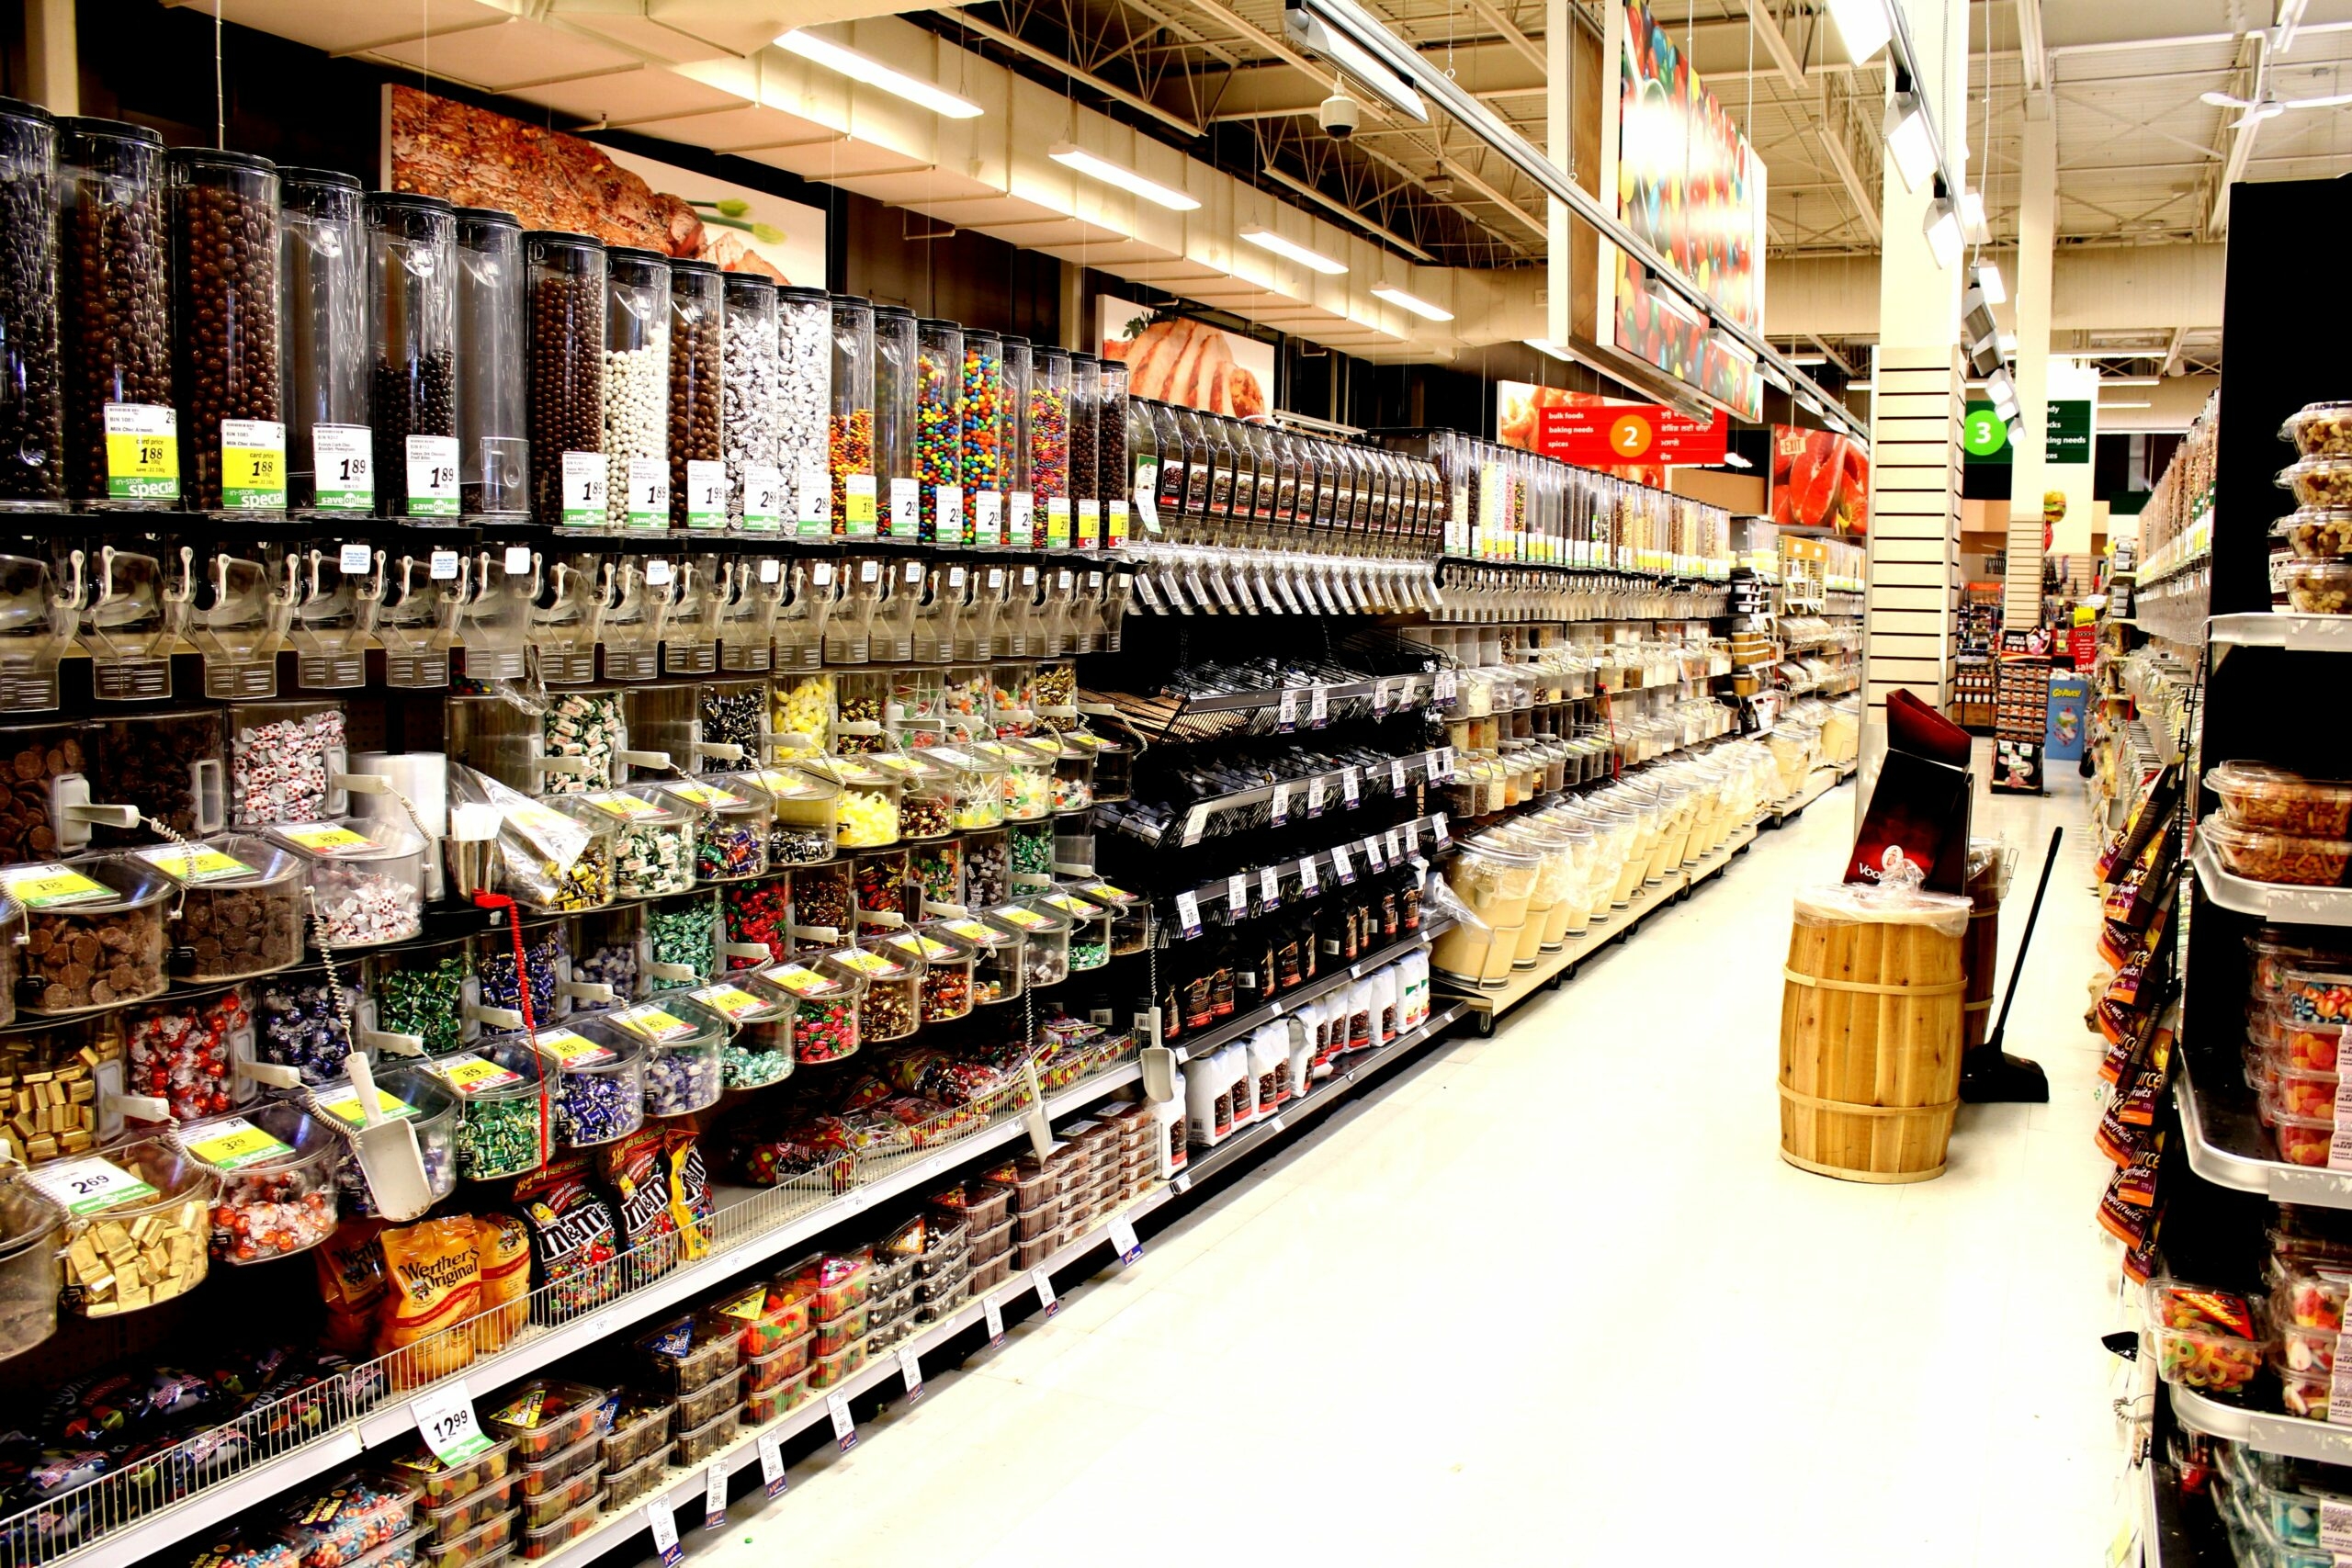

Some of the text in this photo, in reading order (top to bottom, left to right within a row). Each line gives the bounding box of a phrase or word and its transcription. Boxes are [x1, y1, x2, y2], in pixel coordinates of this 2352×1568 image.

[1623, 426, 1638, 446] 2
[1975, 423, 1991, 443] 3
[1785, 439, 1801, 453] EXIT
[129, 478, 176, 497] special
[241, 490, 285, 509] special
[2075, 662, 2095, 671] sale
[463, 1066, 482, 1078] 89
[221, 1138, 245, 1151] 329
[71, 1175, 111, 1194] 269
[398, 1245, 481, 1281] Werther's
[422, 1258, 478, 1290] Original
[434, 1410, 469, 1443] 1299
